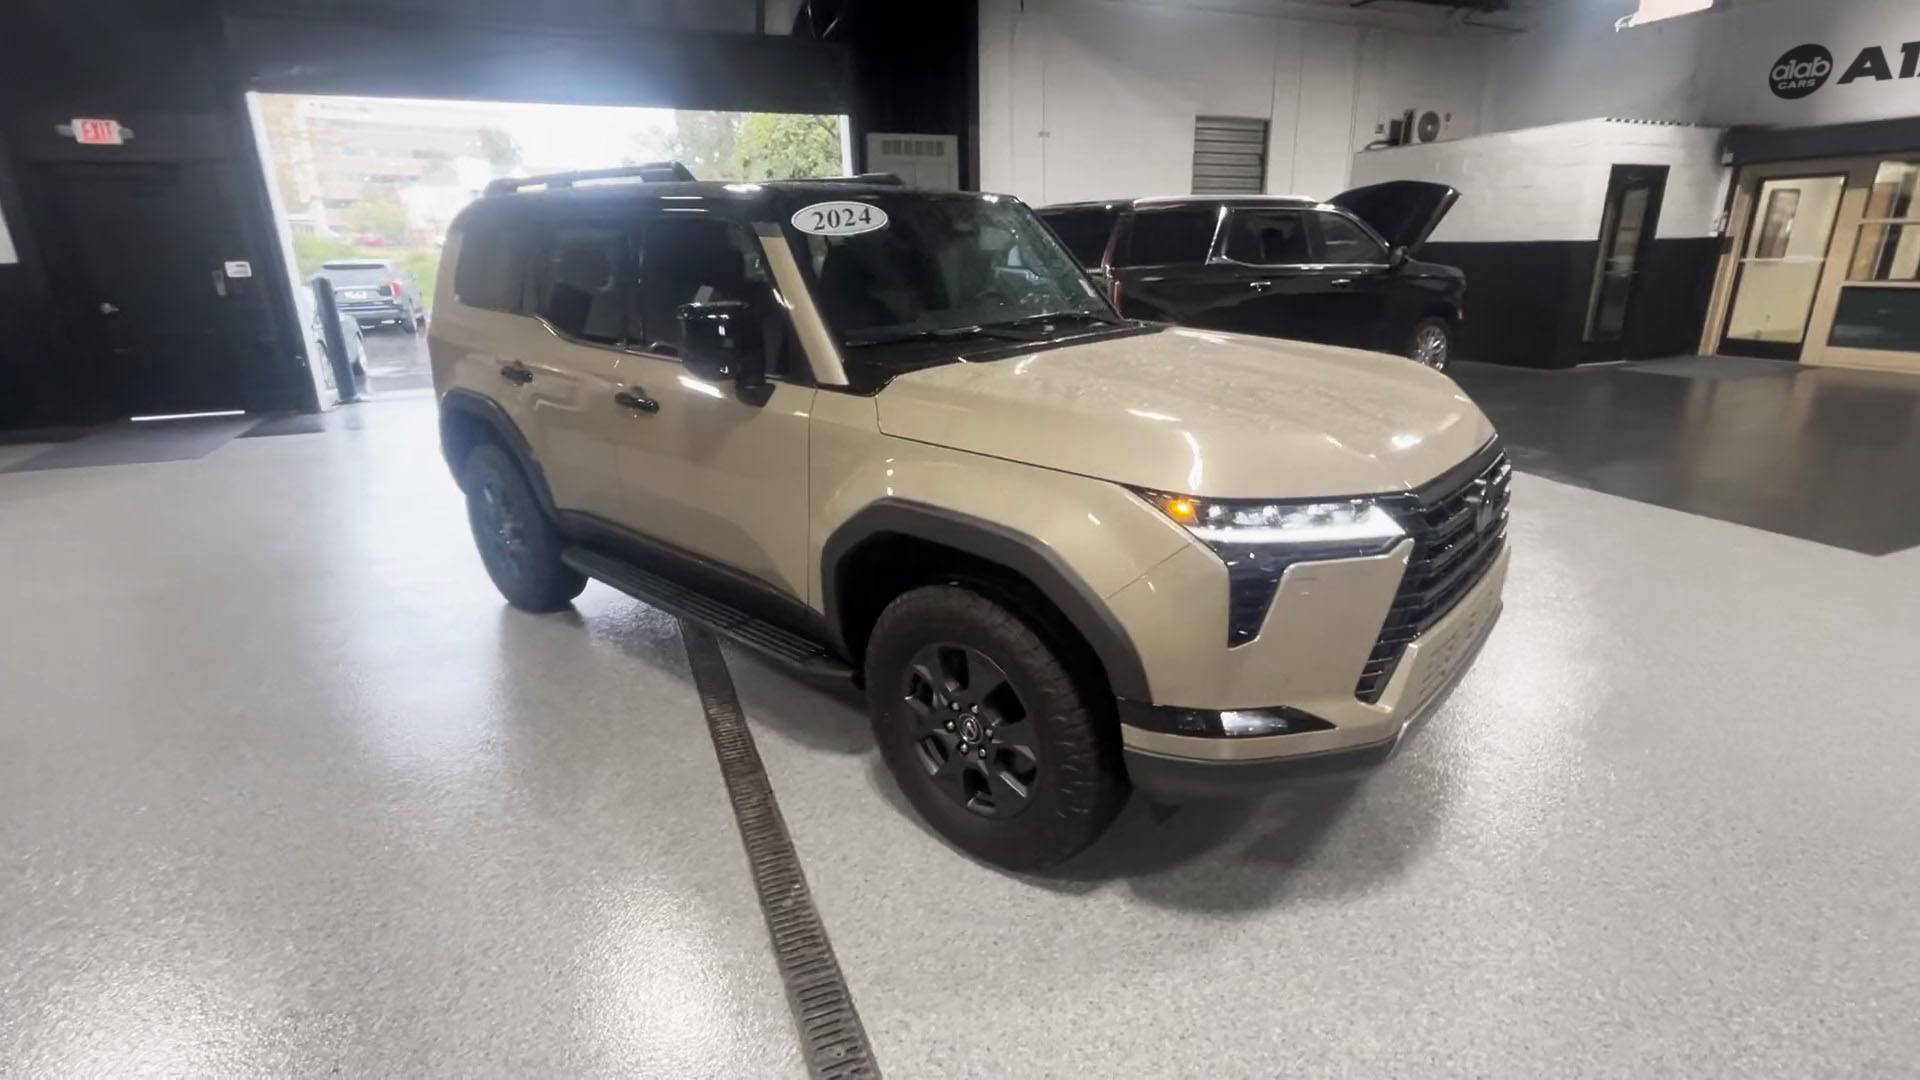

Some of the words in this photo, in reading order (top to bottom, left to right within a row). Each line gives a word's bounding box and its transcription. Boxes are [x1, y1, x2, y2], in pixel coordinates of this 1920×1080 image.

[1836, 41, 1920, 84] A1
[1777, 79, 1817, 90] CARS
[81, 120, 112, 140] EXIT
[811, 207, 872, 231] 2024
